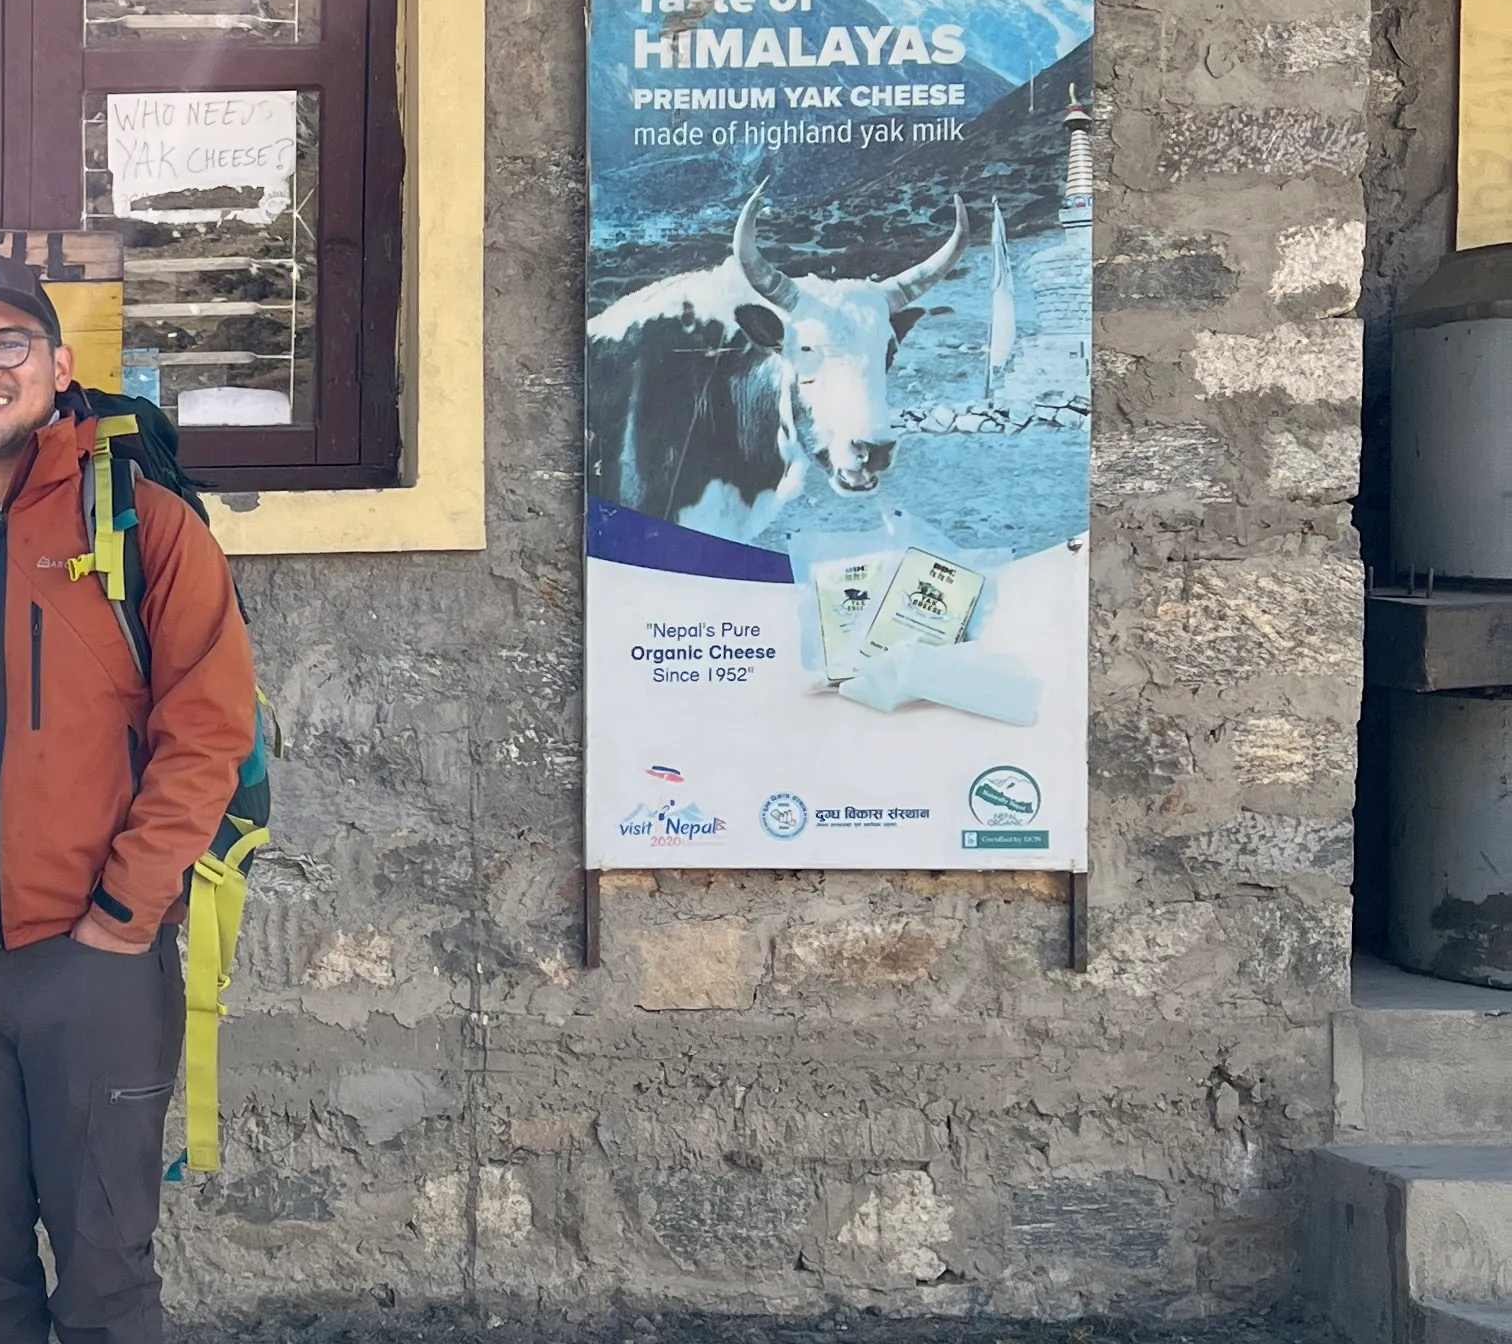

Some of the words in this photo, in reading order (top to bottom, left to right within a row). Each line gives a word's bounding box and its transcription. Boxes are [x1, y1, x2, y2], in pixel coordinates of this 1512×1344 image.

[633, 24, 966, 69] HIMALAYAS
[633, 86, 776, 110] PREMIUM
[784, 86, 841, 108] YAK
[850, 83, 965, 107] CHEESE
[114, 99, 176, 131] WHO
[633, 122, 703, 147] made
[711, 121, 737, 146] of
[744, 118, 852, 150] highland
[860, 118, 903, 149] yak
[913, 117, 964, 143] milk
[116, 139, 178, 181] YAK
[188, 137, 294, 173] CHEESE?
[646, 621, 716, 641] "Nepal's
[721, 622, 761, 637] Pure
[631, 645, 703, 663] Organic
[709, 645, 776, 659] Cheese
[653, 667, 700, 682] Since
[708, 666, 754, 682] 1952"
[815, 808, 841, 822] दुग्ध
[887, 806, 930, 820] संस्थान
[619, 821, 653, 835] visit
[666, 817, 716, 840] Nepal
[650, 836, 681, 847] 2020
